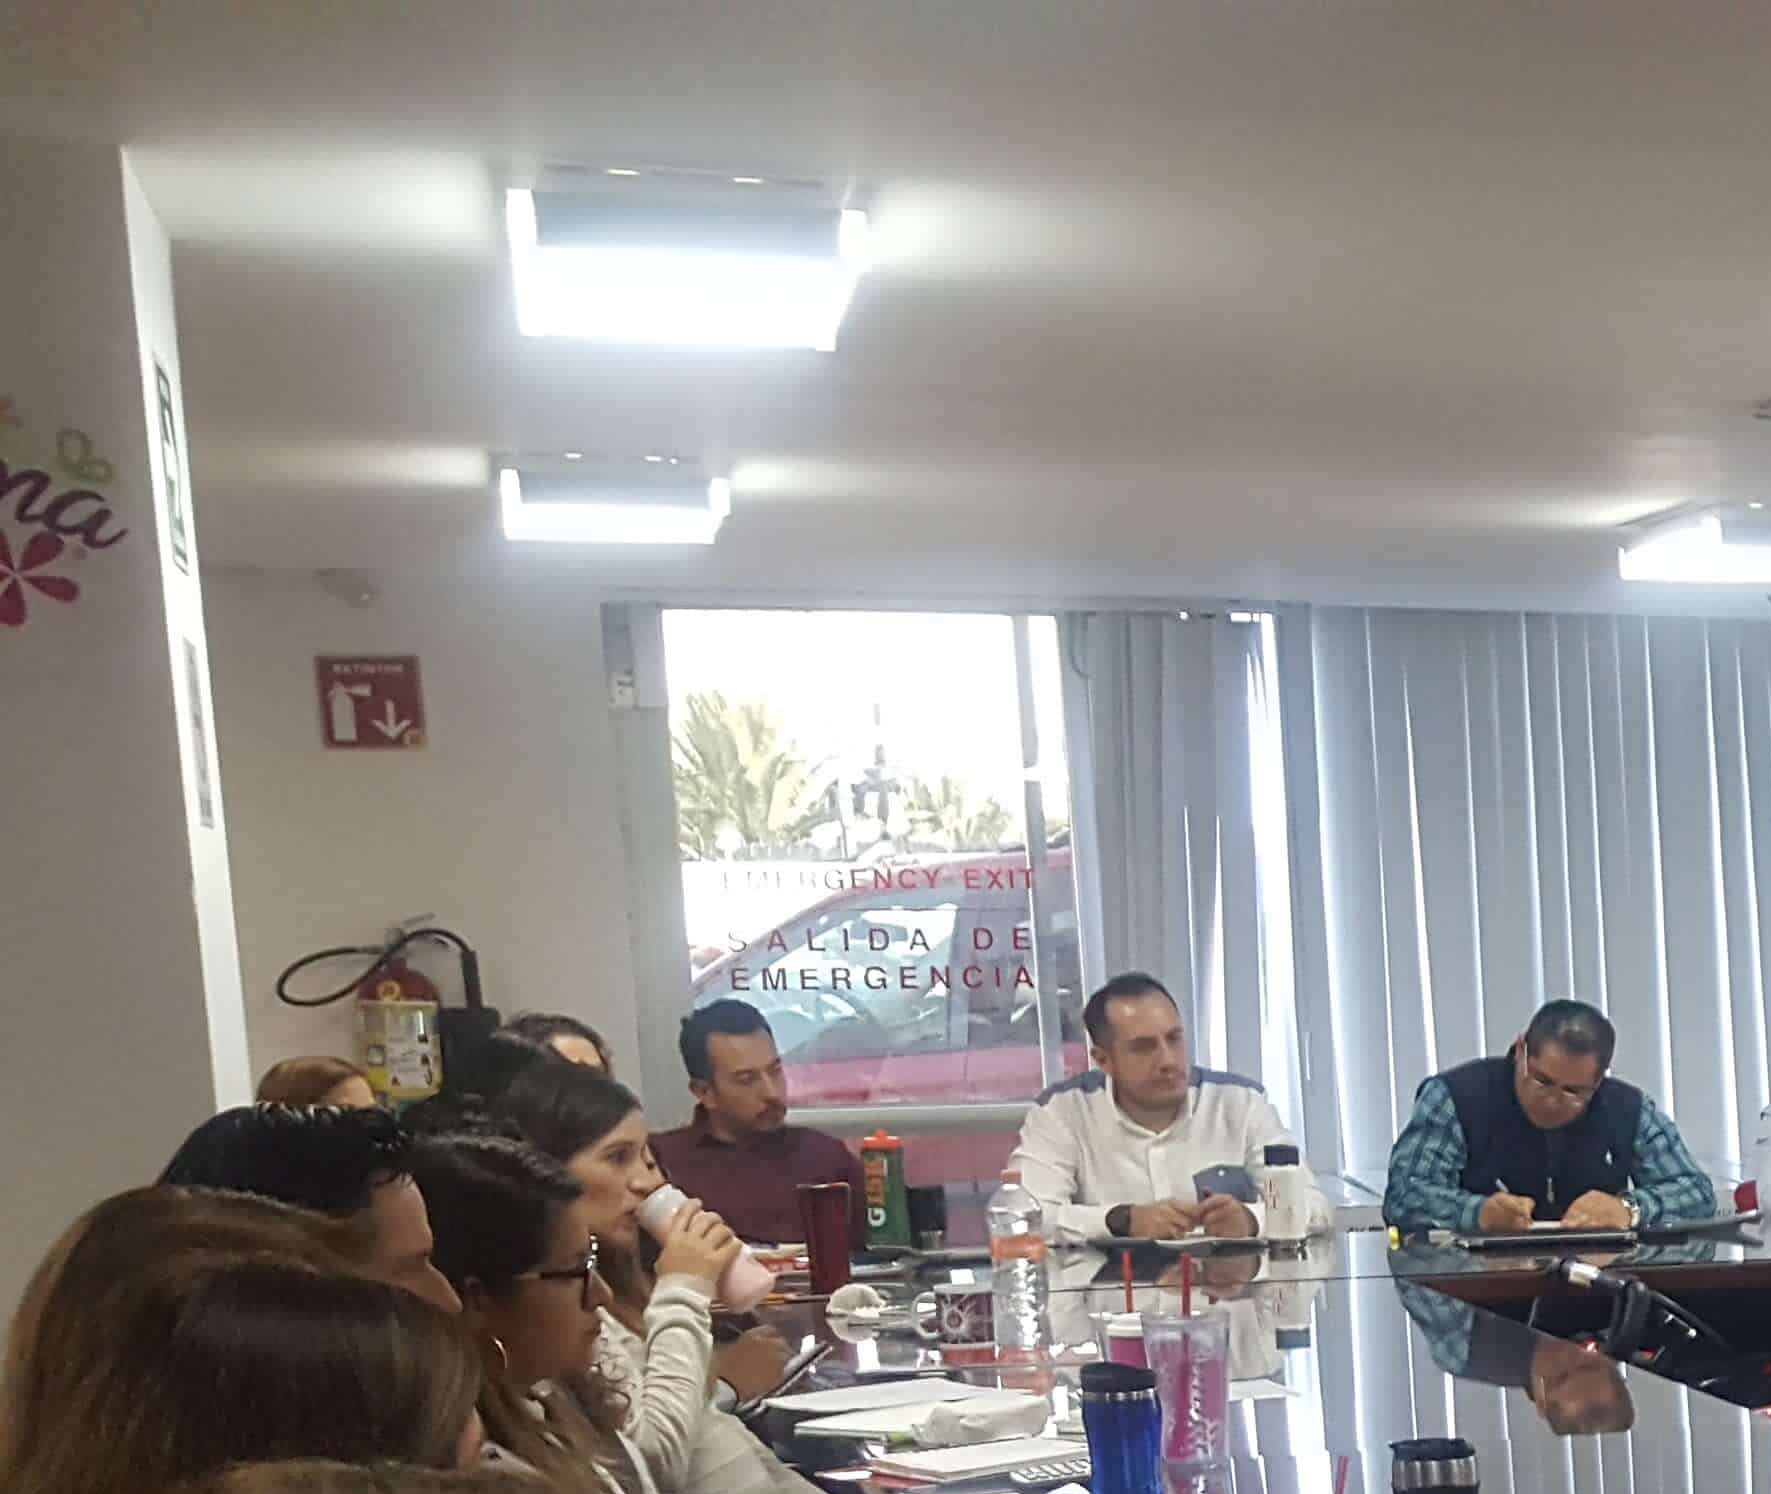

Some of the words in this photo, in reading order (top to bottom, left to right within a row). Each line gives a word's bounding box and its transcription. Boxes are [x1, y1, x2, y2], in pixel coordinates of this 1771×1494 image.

[963, 867, 1035, 890] EXIT
[727, 927, 932, 953] SALIDA
[973, 927, 1031, 951] DE
[730, 965, 1036, 991] EMERGENCIA
